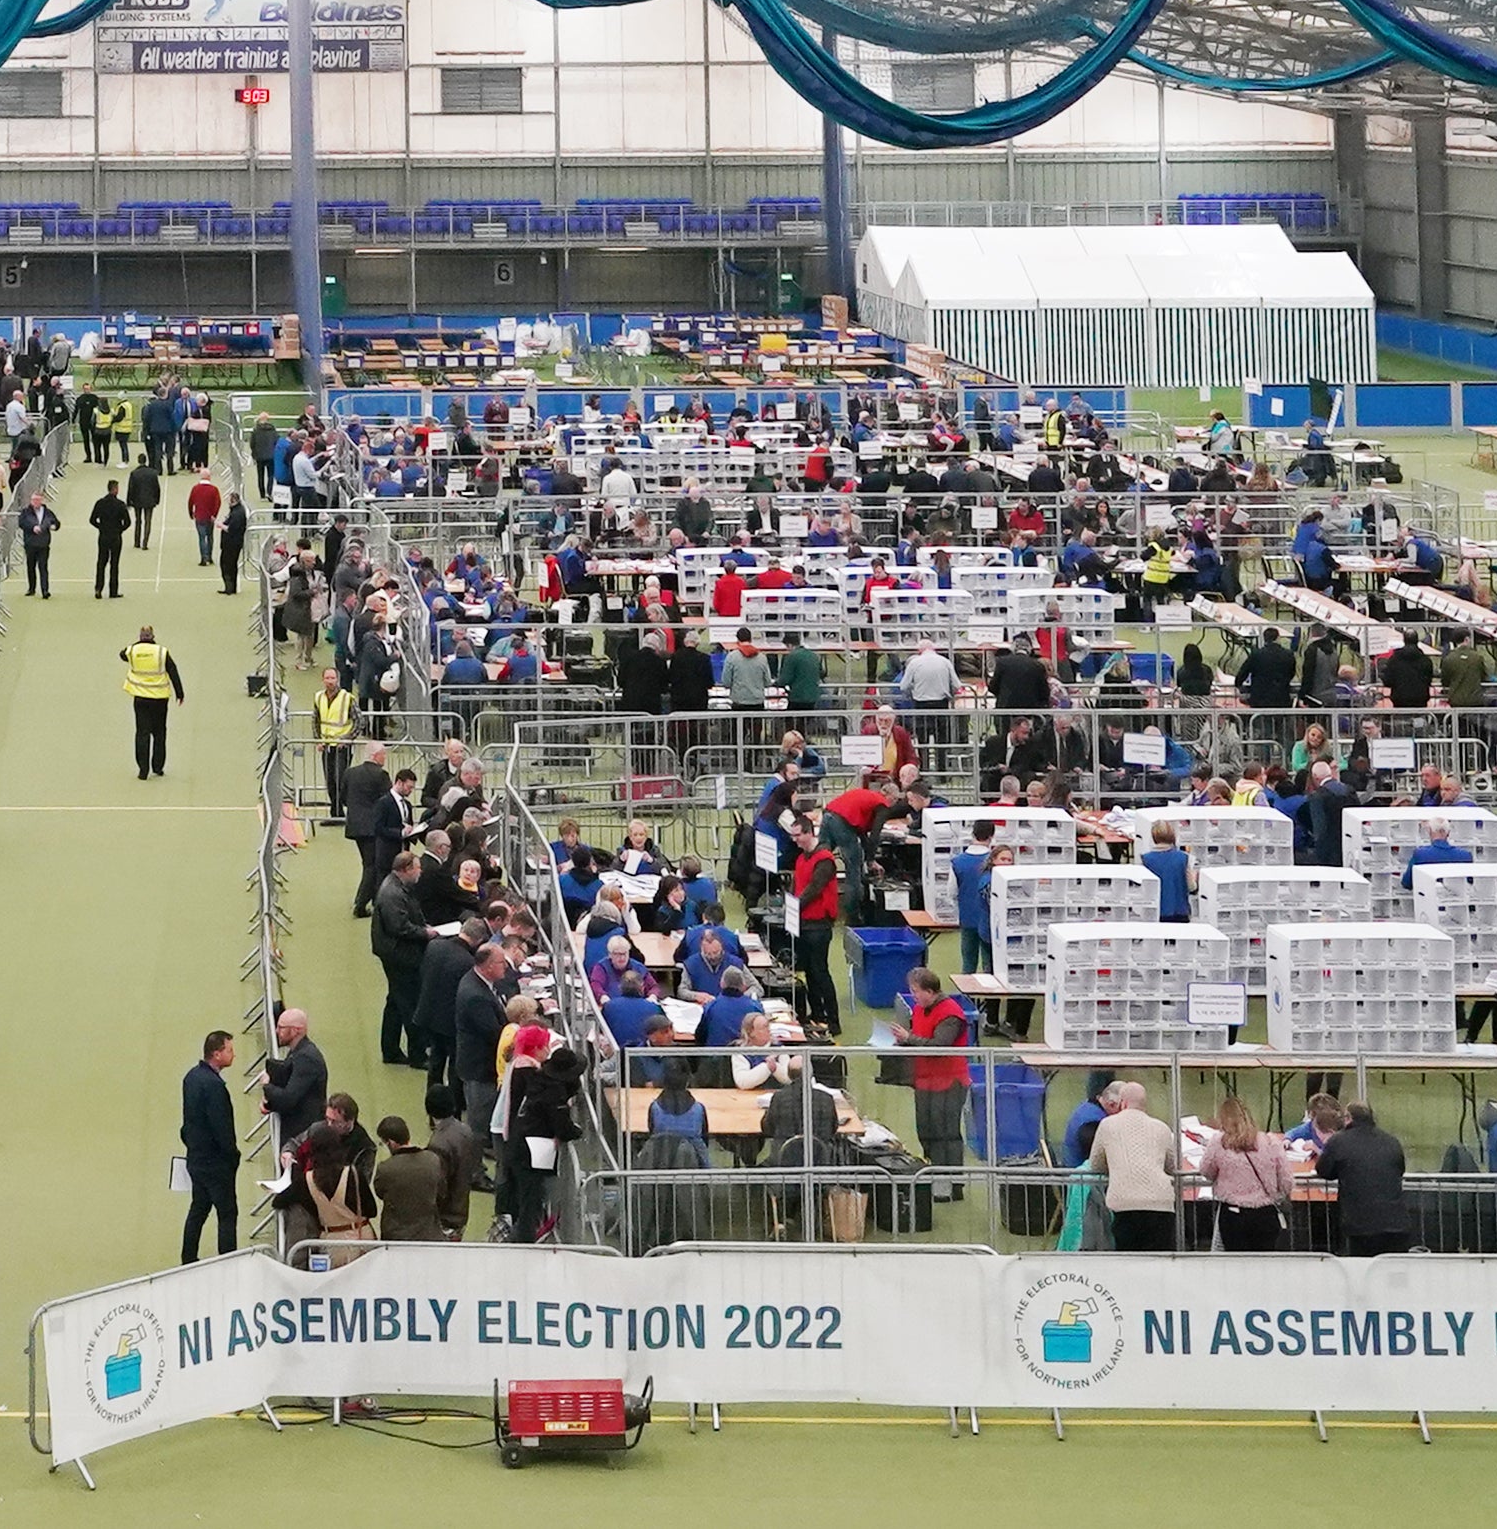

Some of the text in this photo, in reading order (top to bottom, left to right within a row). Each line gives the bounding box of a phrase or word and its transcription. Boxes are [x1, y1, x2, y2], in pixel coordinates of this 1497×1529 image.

[100, 13, 191, 22] BUILDING SYSTEMS
[140, 48, 161, 69] All
[163, 48, 221, 70] weather
[224, 47, 278, 70] training
[6, 266, 18, 285] 5
[497, 263, 510, 282] 6
[1015, 1274, 1123, 1321] THE ELECTORAL OFFICE
[85, 1303, 164, 1363] THE ELECTORAL OFFICE
[179, 1297, 843, 1369] NI ASSEMBLY ELECTION 2022
[1144, 1309, 1191, 1355] NI
[1210, 1309, 1474, 1356] ASSEMBLY
[1015, 1338, 1123, 1389] FOR NORTHERN IRELAND
[85, 1359, 165, 1424] FOR NORTHERN IRELAND
